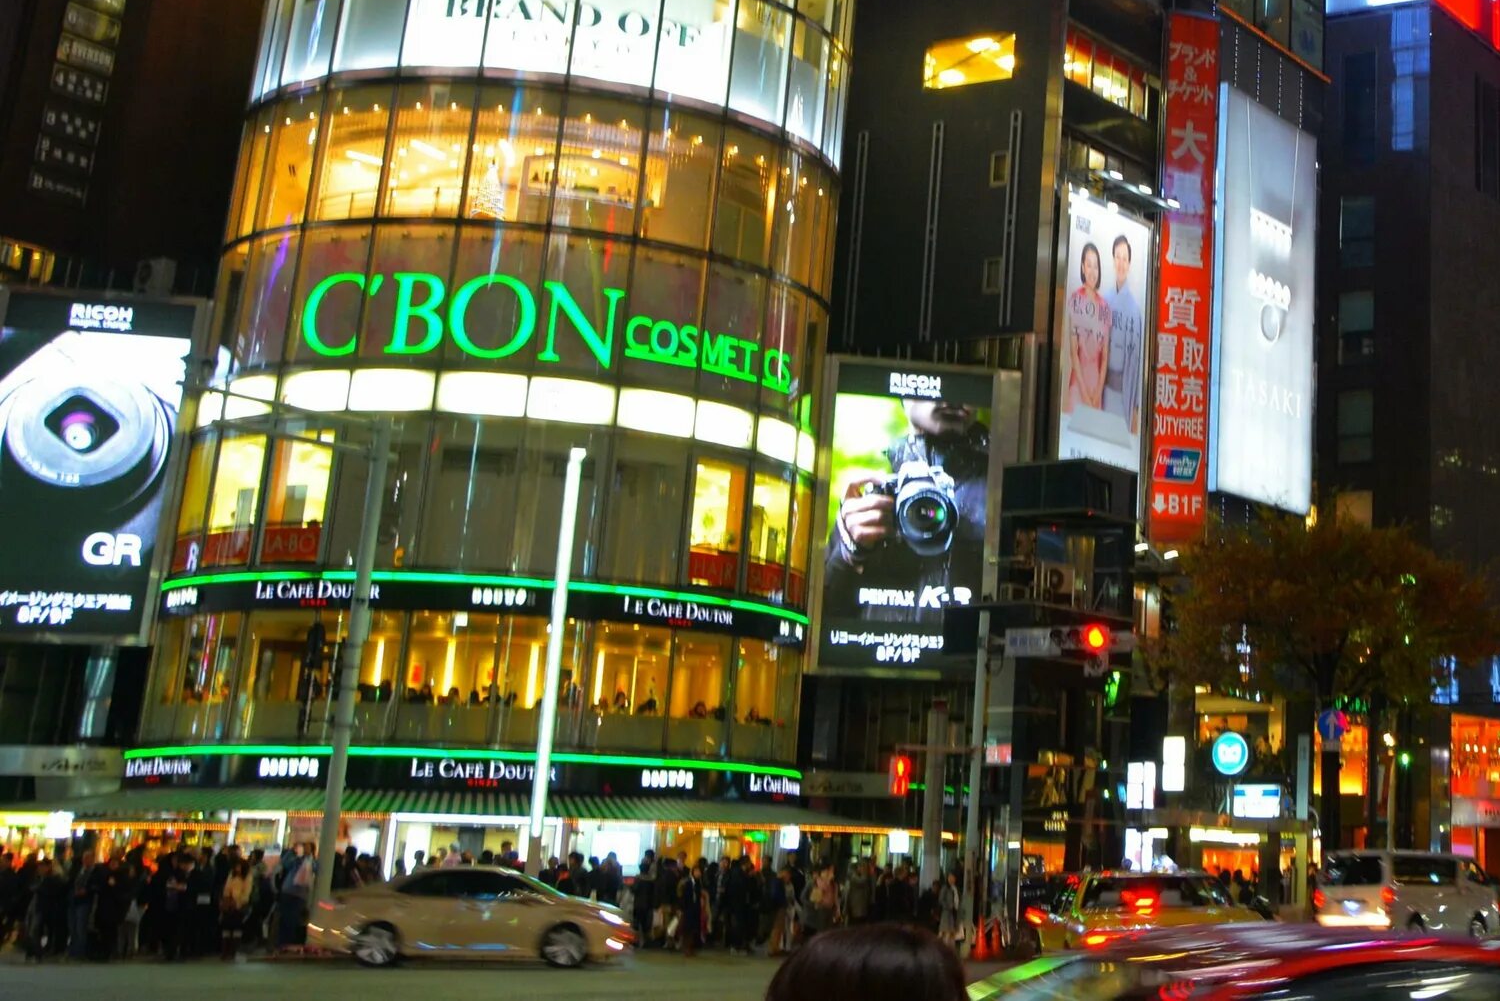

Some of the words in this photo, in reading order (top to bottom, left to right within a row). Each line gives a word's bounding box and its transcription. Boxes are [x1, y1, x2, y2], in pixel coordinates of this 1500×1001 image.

[1168, 41, 1216, 69] ブランド
[1184, 66, 1197, 82] &
[1167, 81, 1214, 106] チケット
[70, 302, 134, 322] RICOH
[302, 272, 625, 369] C'BON
[1157, 332, 1205, 373] 買取
[889, 372, 942, 391] RICOH
[1156, 374, 1204, 413] 販売
[1231, 368, 1302, 419] TASAKI
[1169, 493, 1203, 516] B1F
[82, 531, 142, 567] GR
[859, 587, 915, 607] PENTAX
[686, 602, 733, 625] DOUTOR
[411, 757, 434, 778] LE
[489, 759, 556, 781] DOUTR
